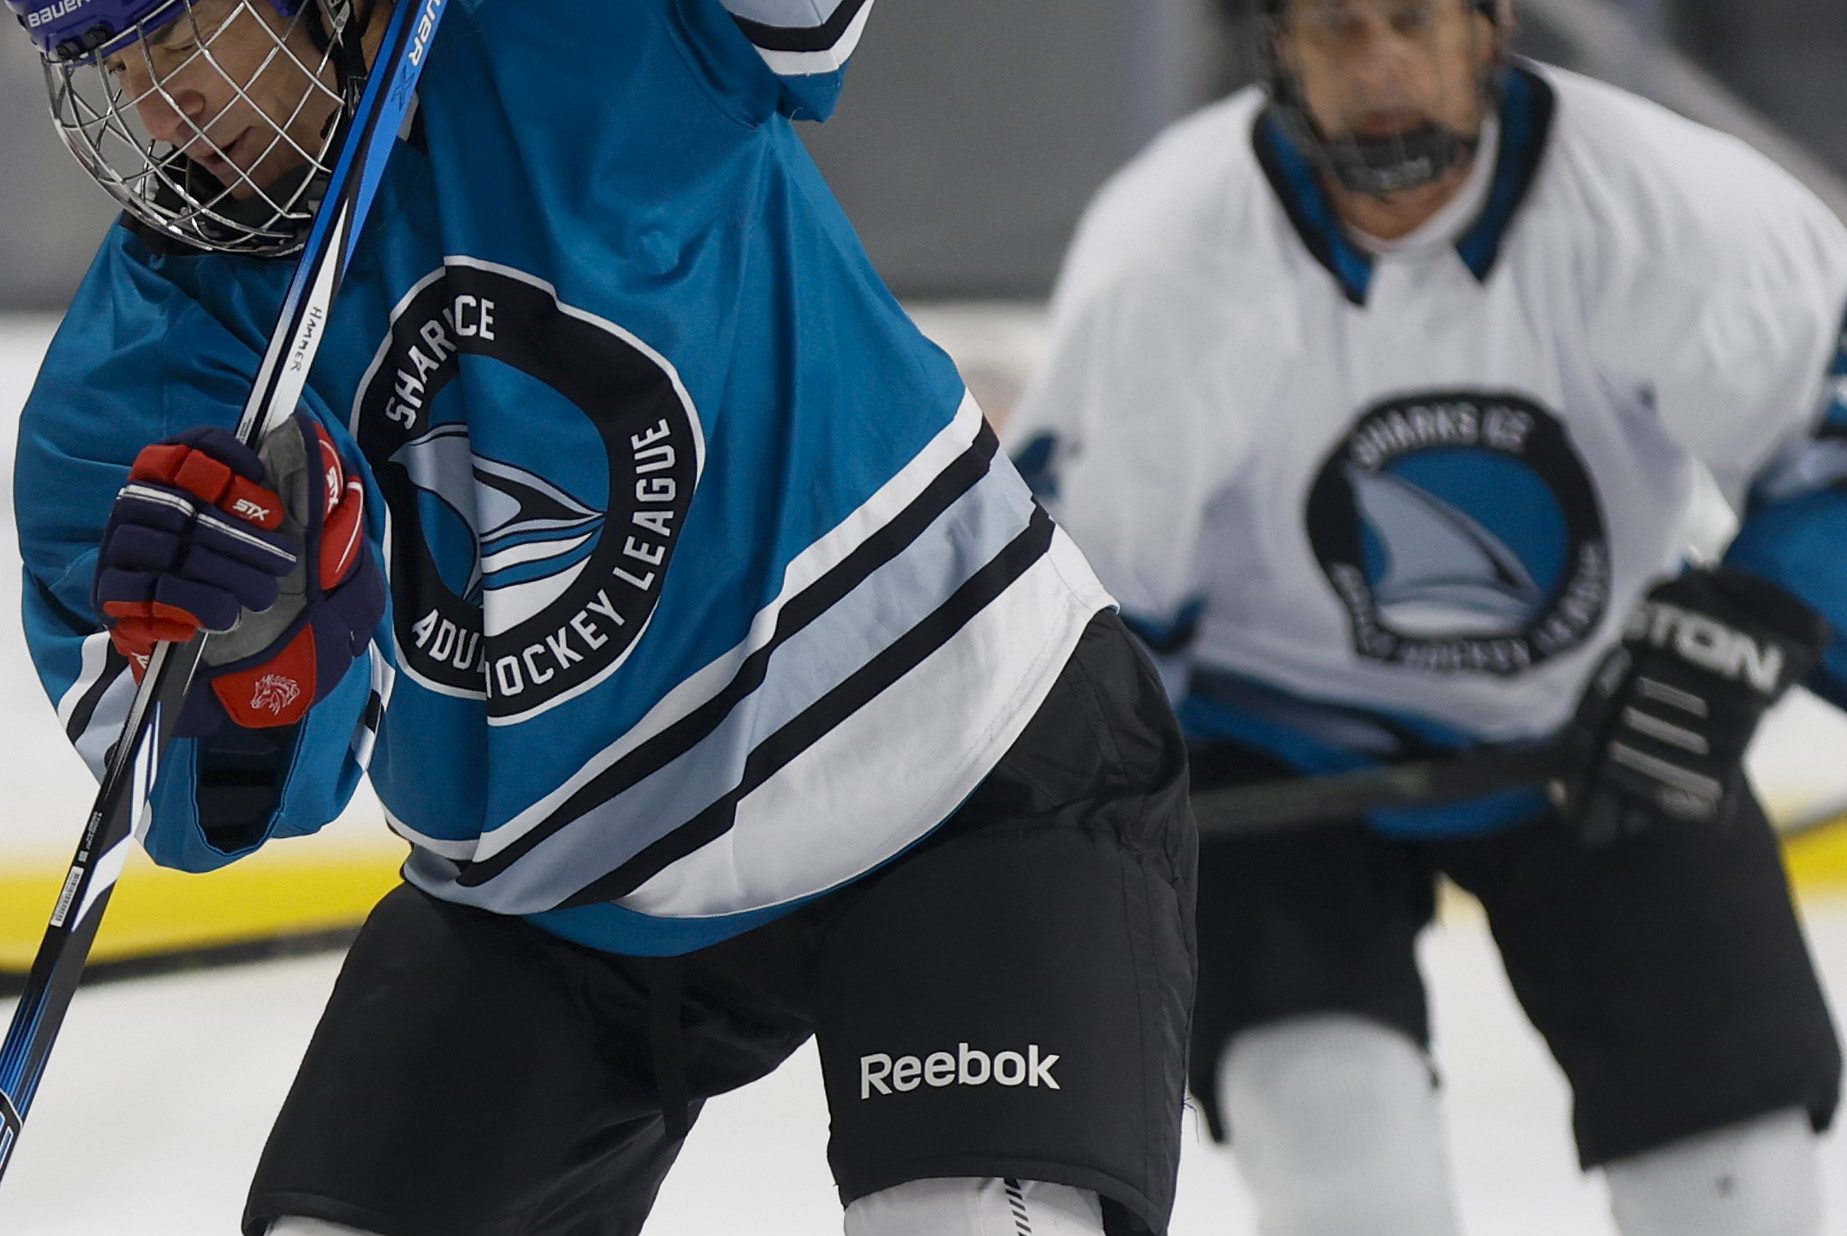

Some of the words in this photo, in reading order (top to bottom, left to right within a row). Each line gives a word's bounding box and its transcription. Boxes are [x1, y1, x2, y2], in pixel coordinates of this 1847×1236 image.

[289, 306, 322, 372] HAMMER
[385, 307, 457, 430] SHAR
[454, 294, 495, 341] CE
[232, 498, 270, 521] STX
[411, 608, 485, 674] ADU
[611, 417, 677, 592] LEAGUE
[859, 1041, 1061, 1100] Reebok
